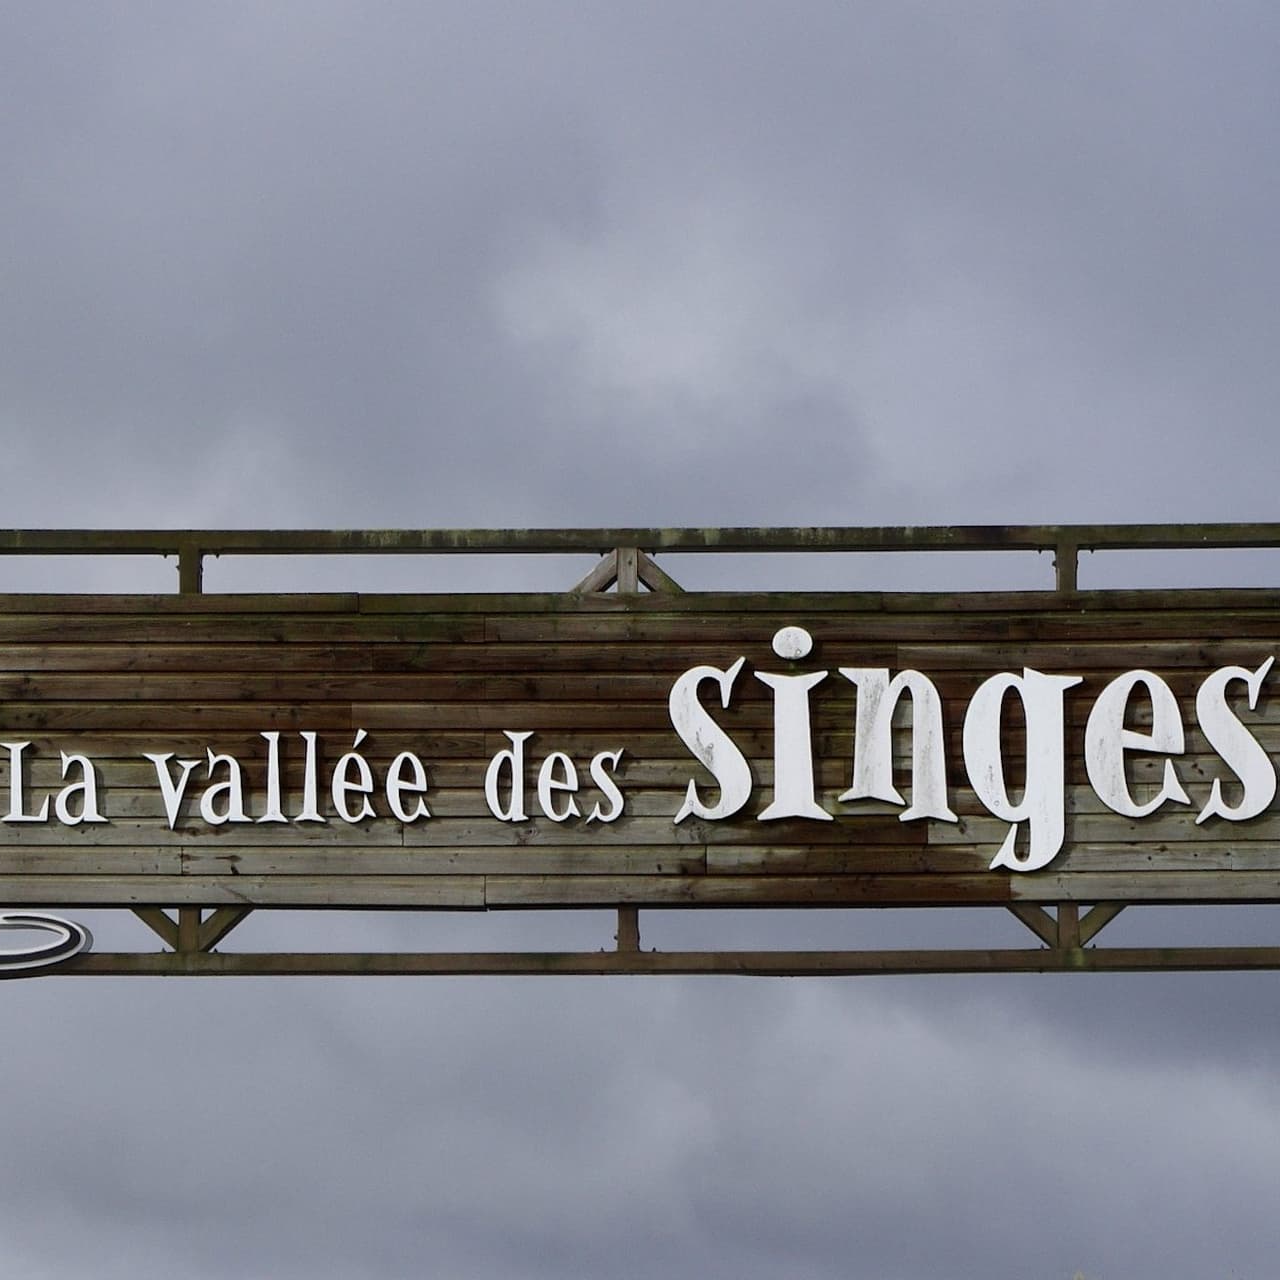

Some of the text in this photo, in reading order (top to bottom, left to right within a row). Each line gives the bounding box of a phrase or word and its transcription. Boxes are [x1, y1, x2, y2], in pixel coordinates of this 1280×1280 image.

[0, 626, 1277, 872] La vallée des singes
